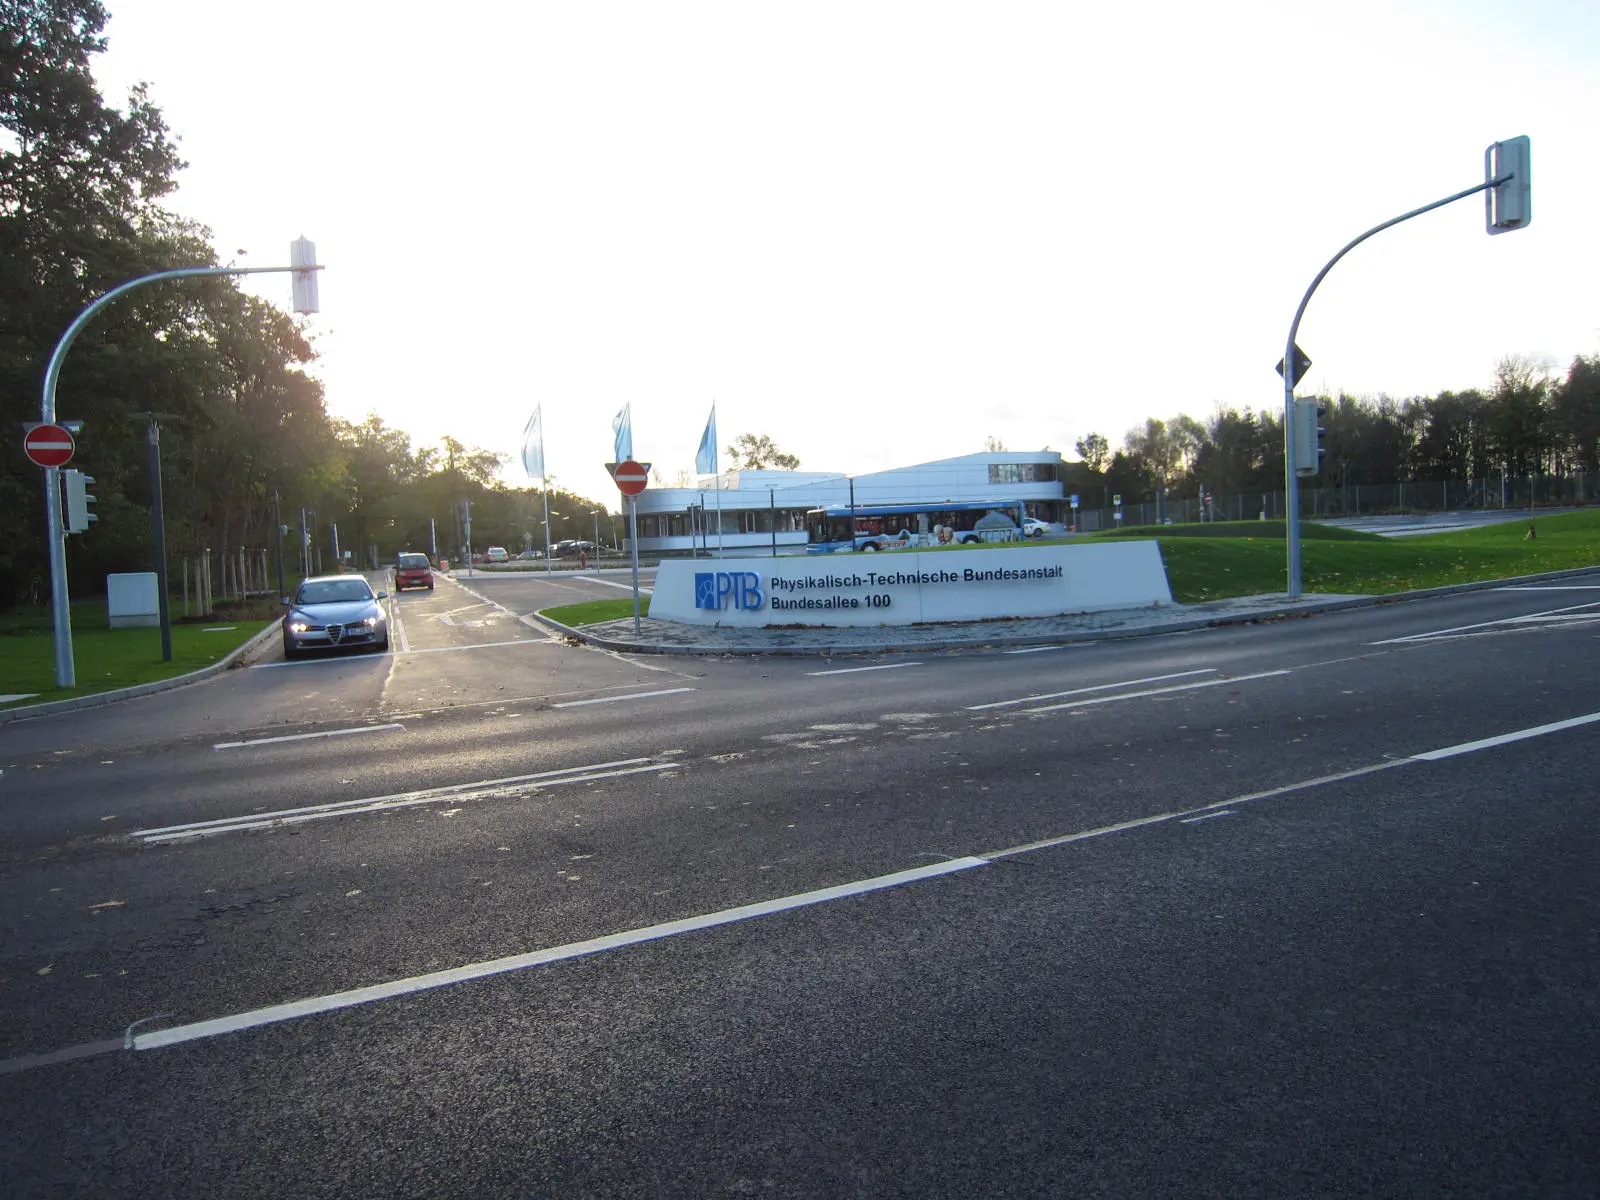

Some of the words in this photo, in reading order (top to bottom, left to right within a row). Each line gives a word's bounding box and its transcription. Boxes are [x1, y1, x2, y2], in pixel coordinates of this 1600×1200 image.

[716, 572, 762, 610] PTB
[771, 570, 958, 592] Physikalisch-Technische
[964, 565, 1063, 581] Bundesanstalt
[771, 595, 859, 609] Bundesallee
[865, 594, 891, 608] 100
